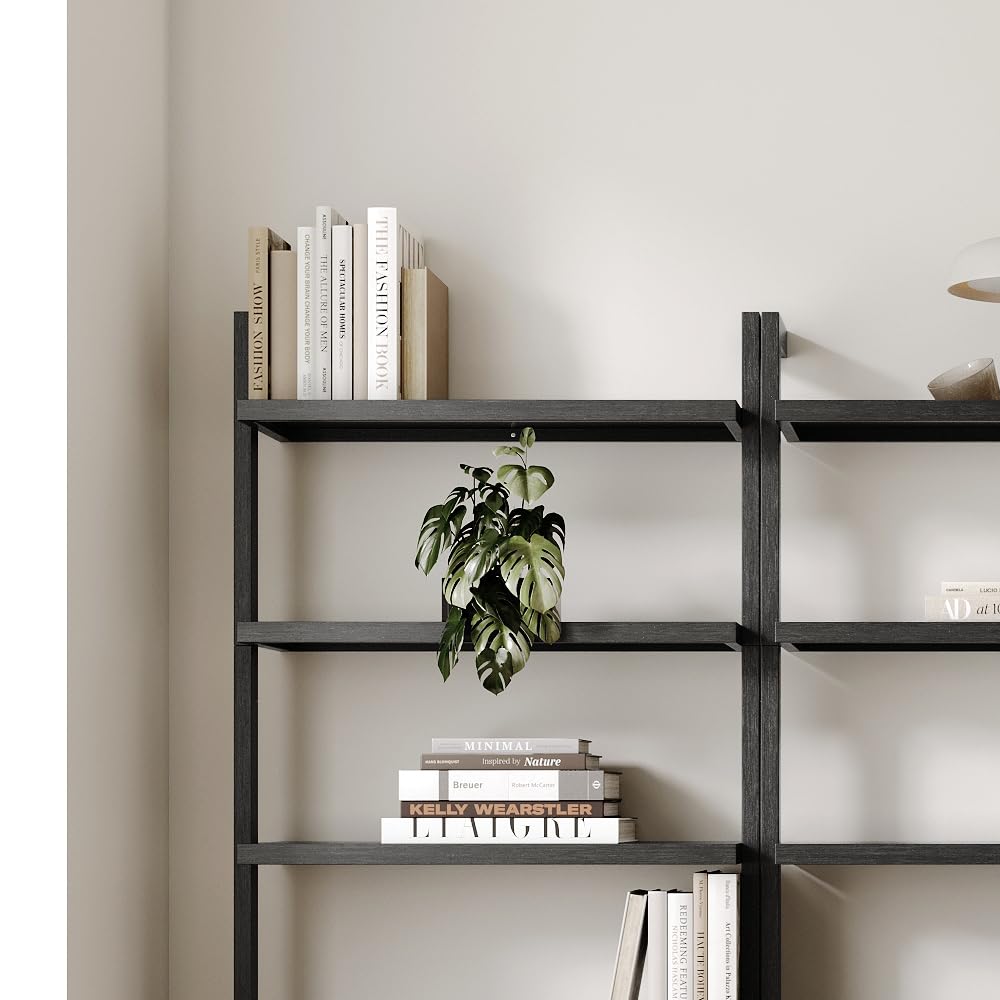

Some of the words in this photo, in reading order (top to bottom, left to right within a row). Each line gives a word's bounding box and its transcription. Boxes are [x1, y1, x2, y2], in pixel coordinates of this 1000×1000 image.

[376, 216, 388, 255] THE
[253, 284, 264, 325] SHOW
[376, 260, 388, 337] FASHION
[320, 316, 328, 328] OF
[253, 331, 264, 391] FASHION
[376, 344, 388, 390] BOOK
[944, 598, 971, 620] AD
[976, 603, 988, 614] at
[464, 742, 533, 750] MINIMAL
[482, 758, 511, 766] Inspired
[512, 758, 521, 766] by
[523, 758, 562, 766] Nature
[409, 803, 467, 816] KELLY
[473, 803, 592, 816] WEARSTLER
